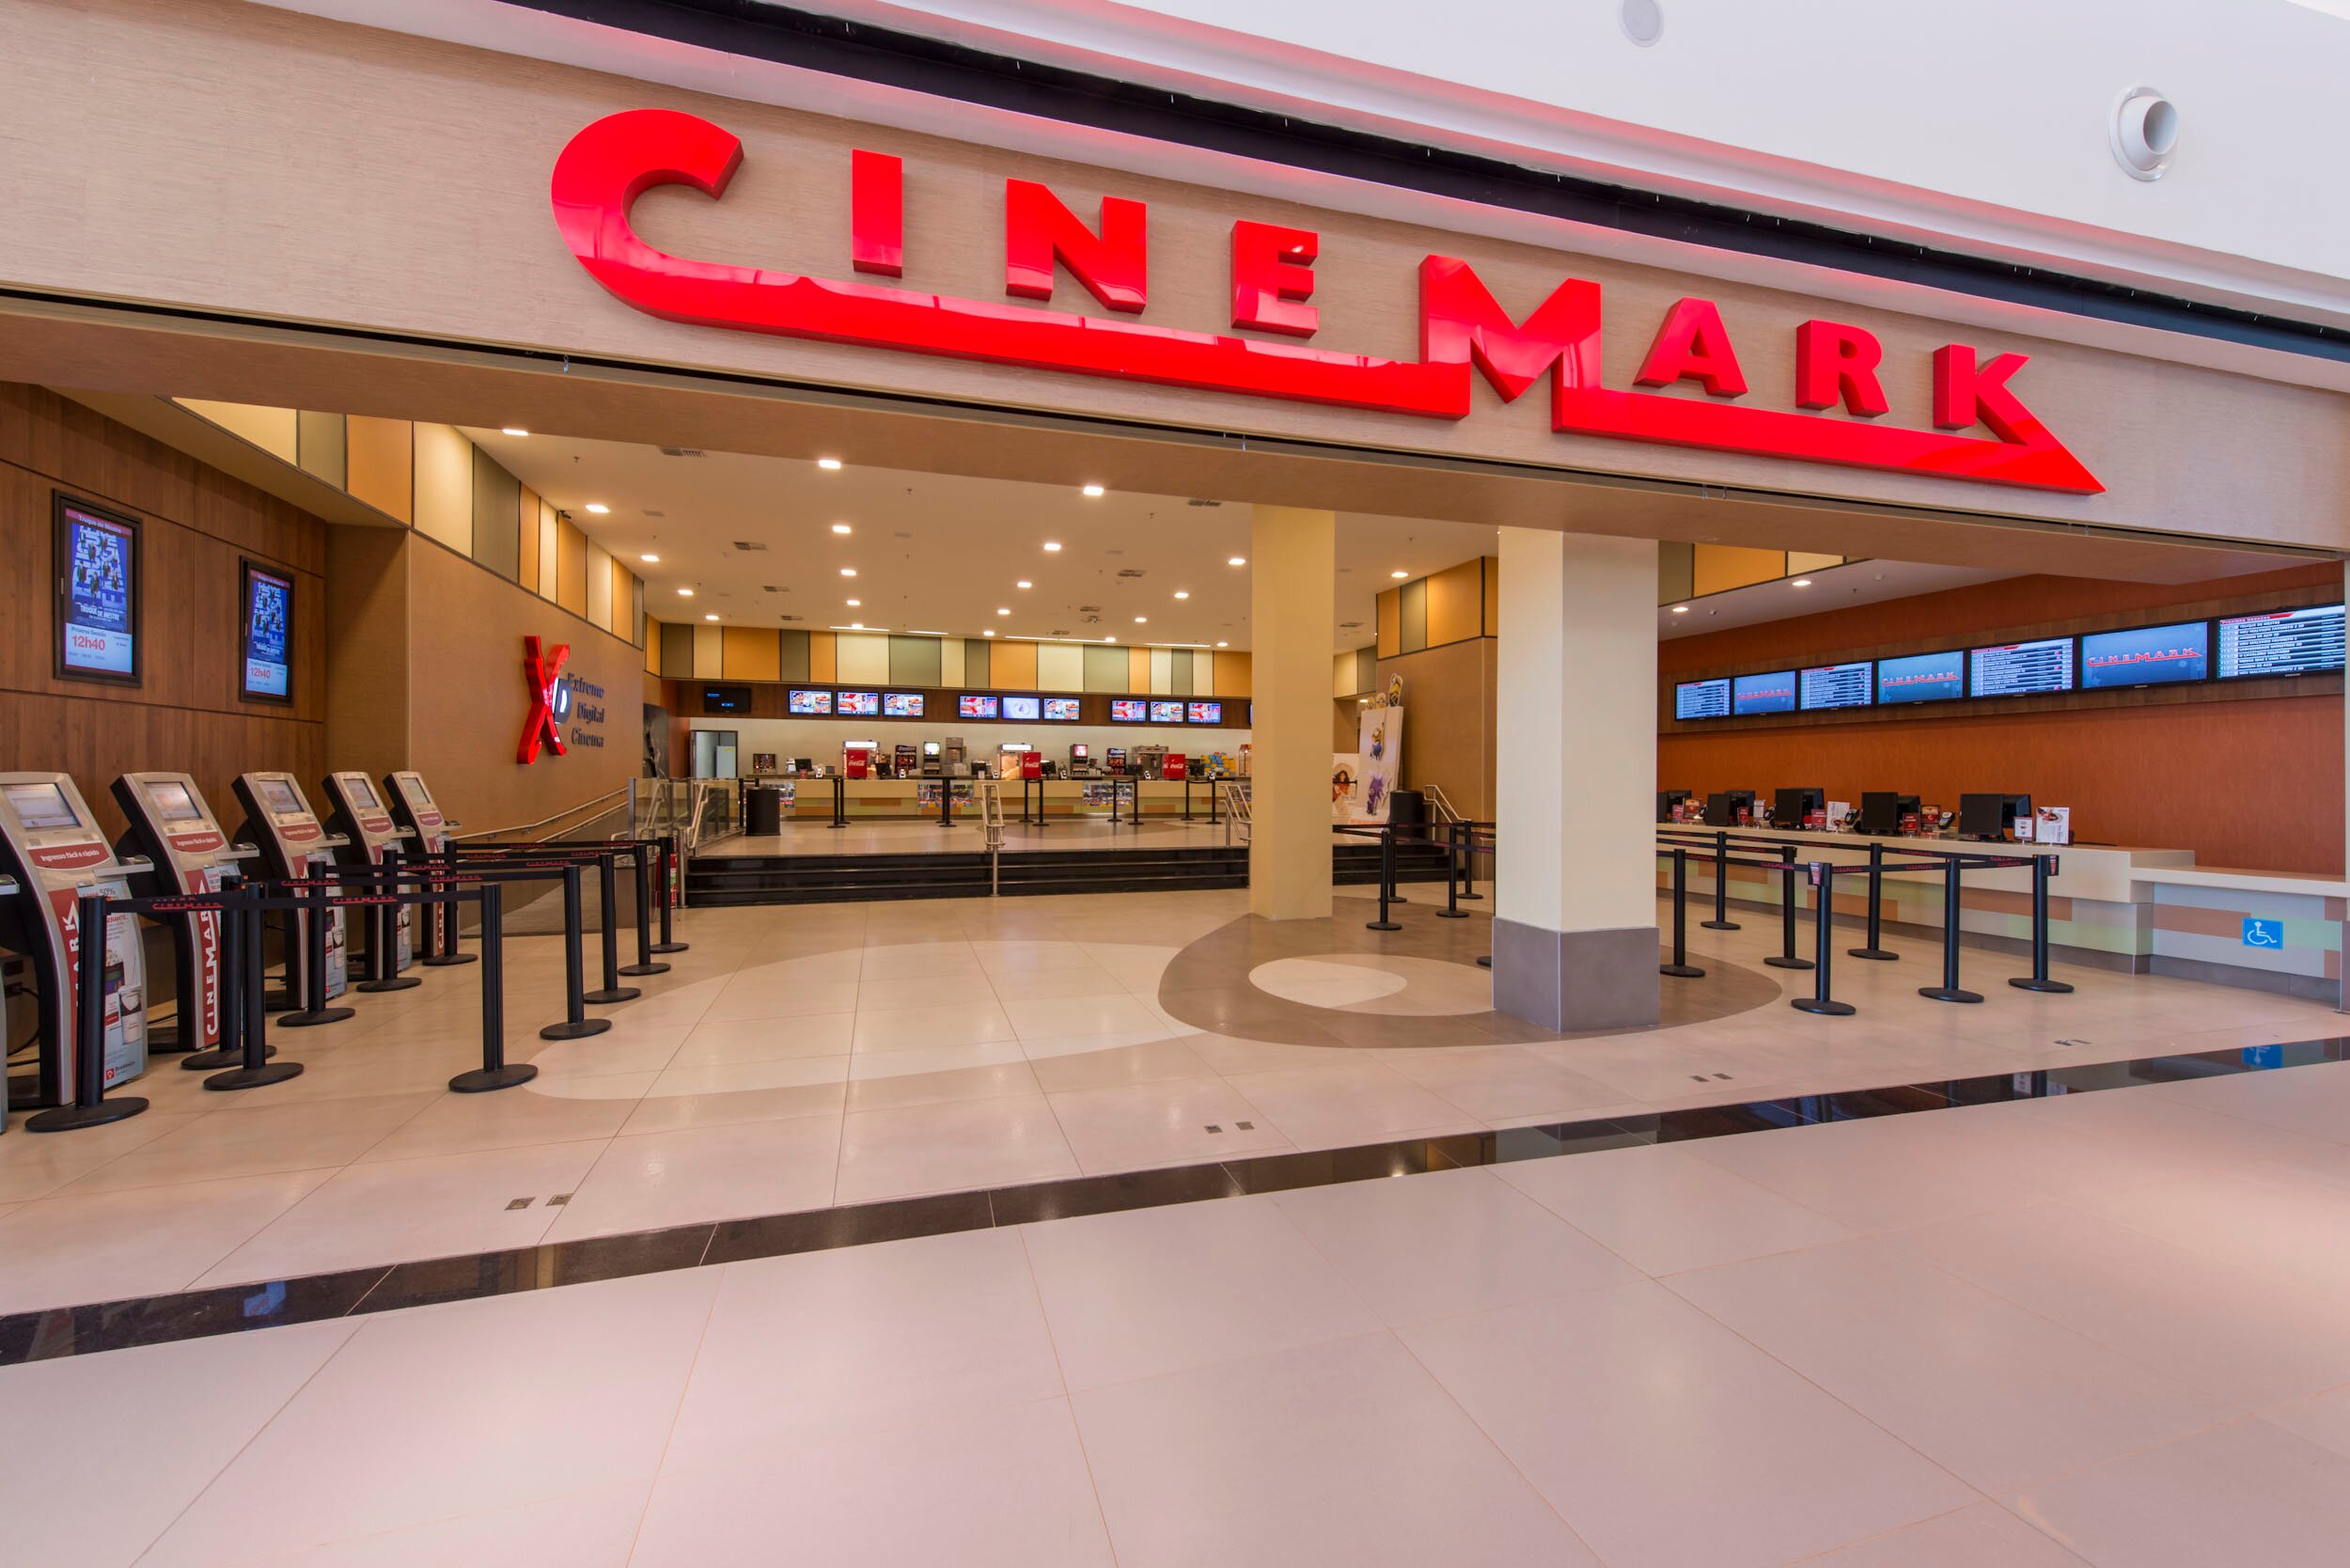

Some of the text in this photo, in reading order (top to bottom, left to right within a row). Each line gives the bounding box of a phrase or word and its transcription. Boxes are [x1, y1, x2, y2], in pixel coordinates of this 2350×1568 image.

[551, 107, 2107, 494] CINEMARK
[72, 635, 105, 651] 12h40
[2087, 647, 2202, 666] CINEMARK
[250, 666, 271, 679] 12h40
[1881, 671, 1960, 687] CINEMARK
[567, 672, 605, 699] Extreme
[577, 701, 605, 725] Digital
[571, 727, 604, 748] Cinema
[40, 852, 66, 862] Ingresso
[66, 850, 78, 859] fácil
[83, 849, 100, 858] rápido
[152, 902, 224, 911] CINEMARK
[333, 896, 399, 904] CINEMARK
[199, 881, 218, 1036] CINEMAR
